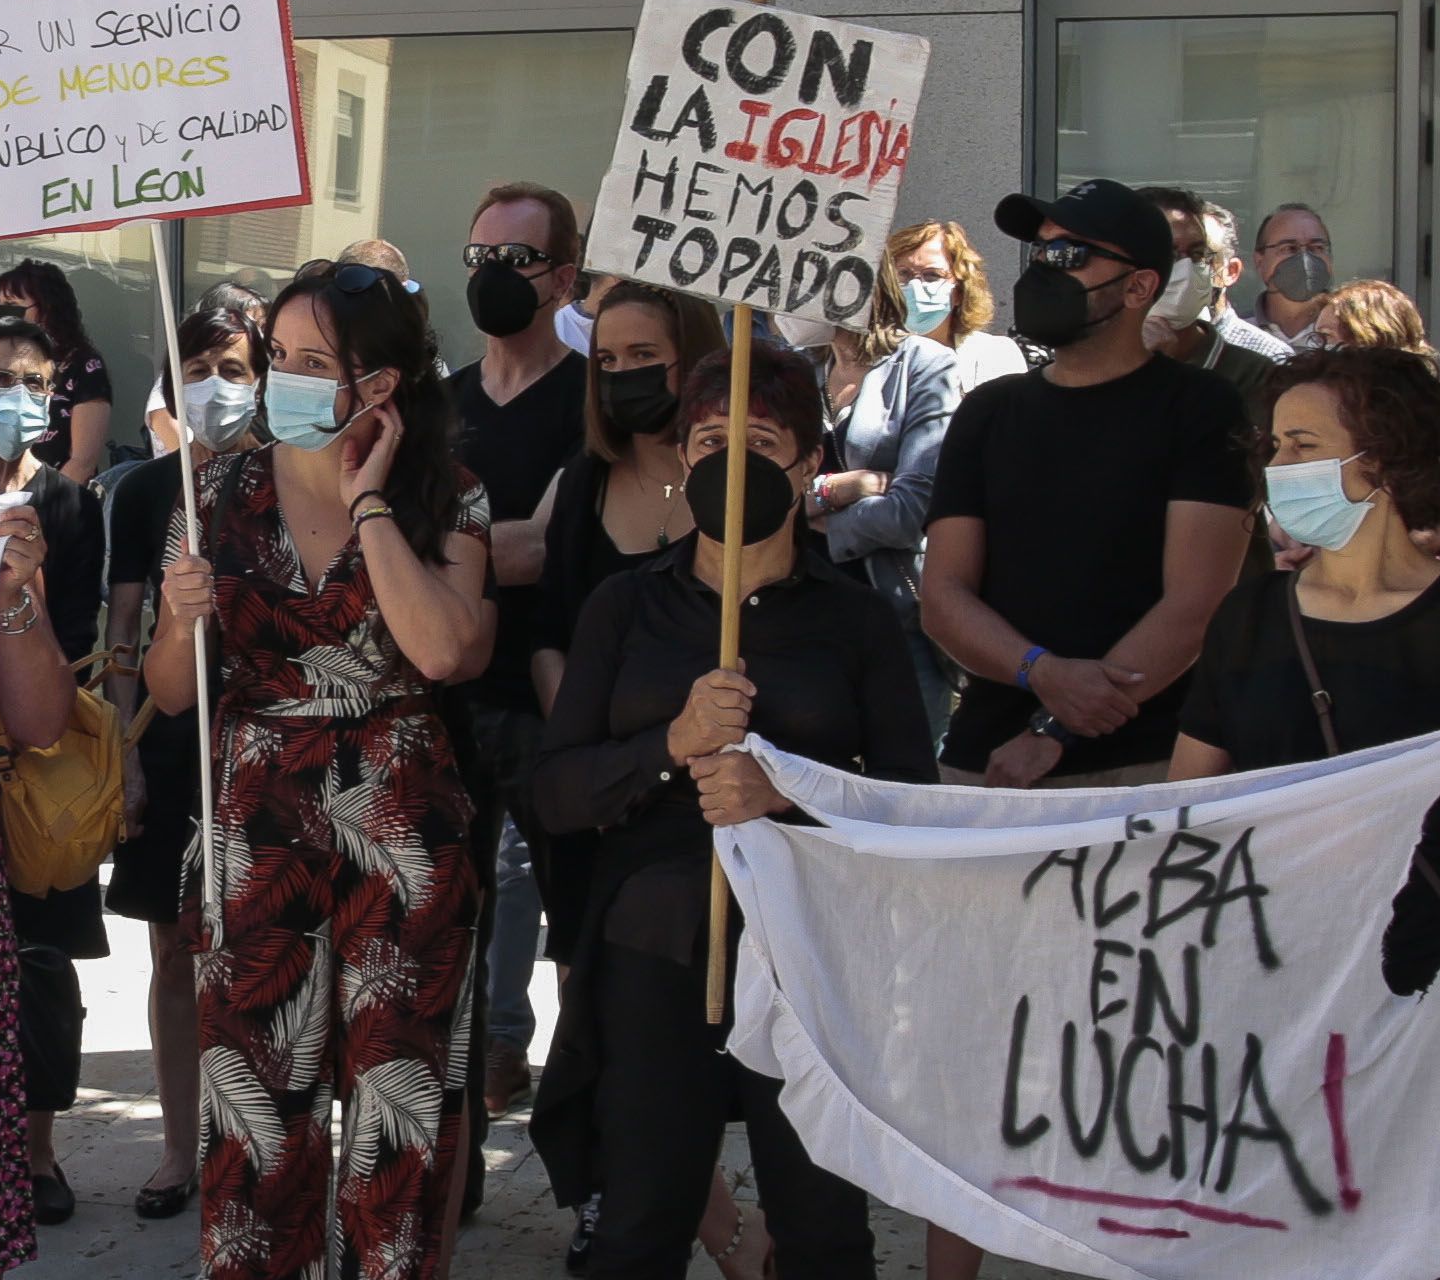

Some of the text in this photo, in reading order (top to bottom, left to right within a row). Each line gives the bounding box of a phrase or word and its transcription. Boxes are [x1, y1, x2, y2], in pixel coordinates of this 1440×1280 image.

[38, 18, 75, 53] UN
[91, 3, 241, 48] SERVICIO
[59, 55, 230, 101] MENORES
[682, 8, 873, 109] CON
[137, 120, 168, 147] DE
[179, 104, 287, 142] CALIDAD
[630, 75, 911, 190] LA IGLESIA
[42, 149, 205, 219] EN LEÓN
[632, 150, 870, 253] HEMOS
[632, 215, 874, 321] TOPADO
[1023, 826, 1281, 970] ALBA
[1090, 939, 1199, 1047] EN
[1002, 994, 1361, 1216] LUCHA!
